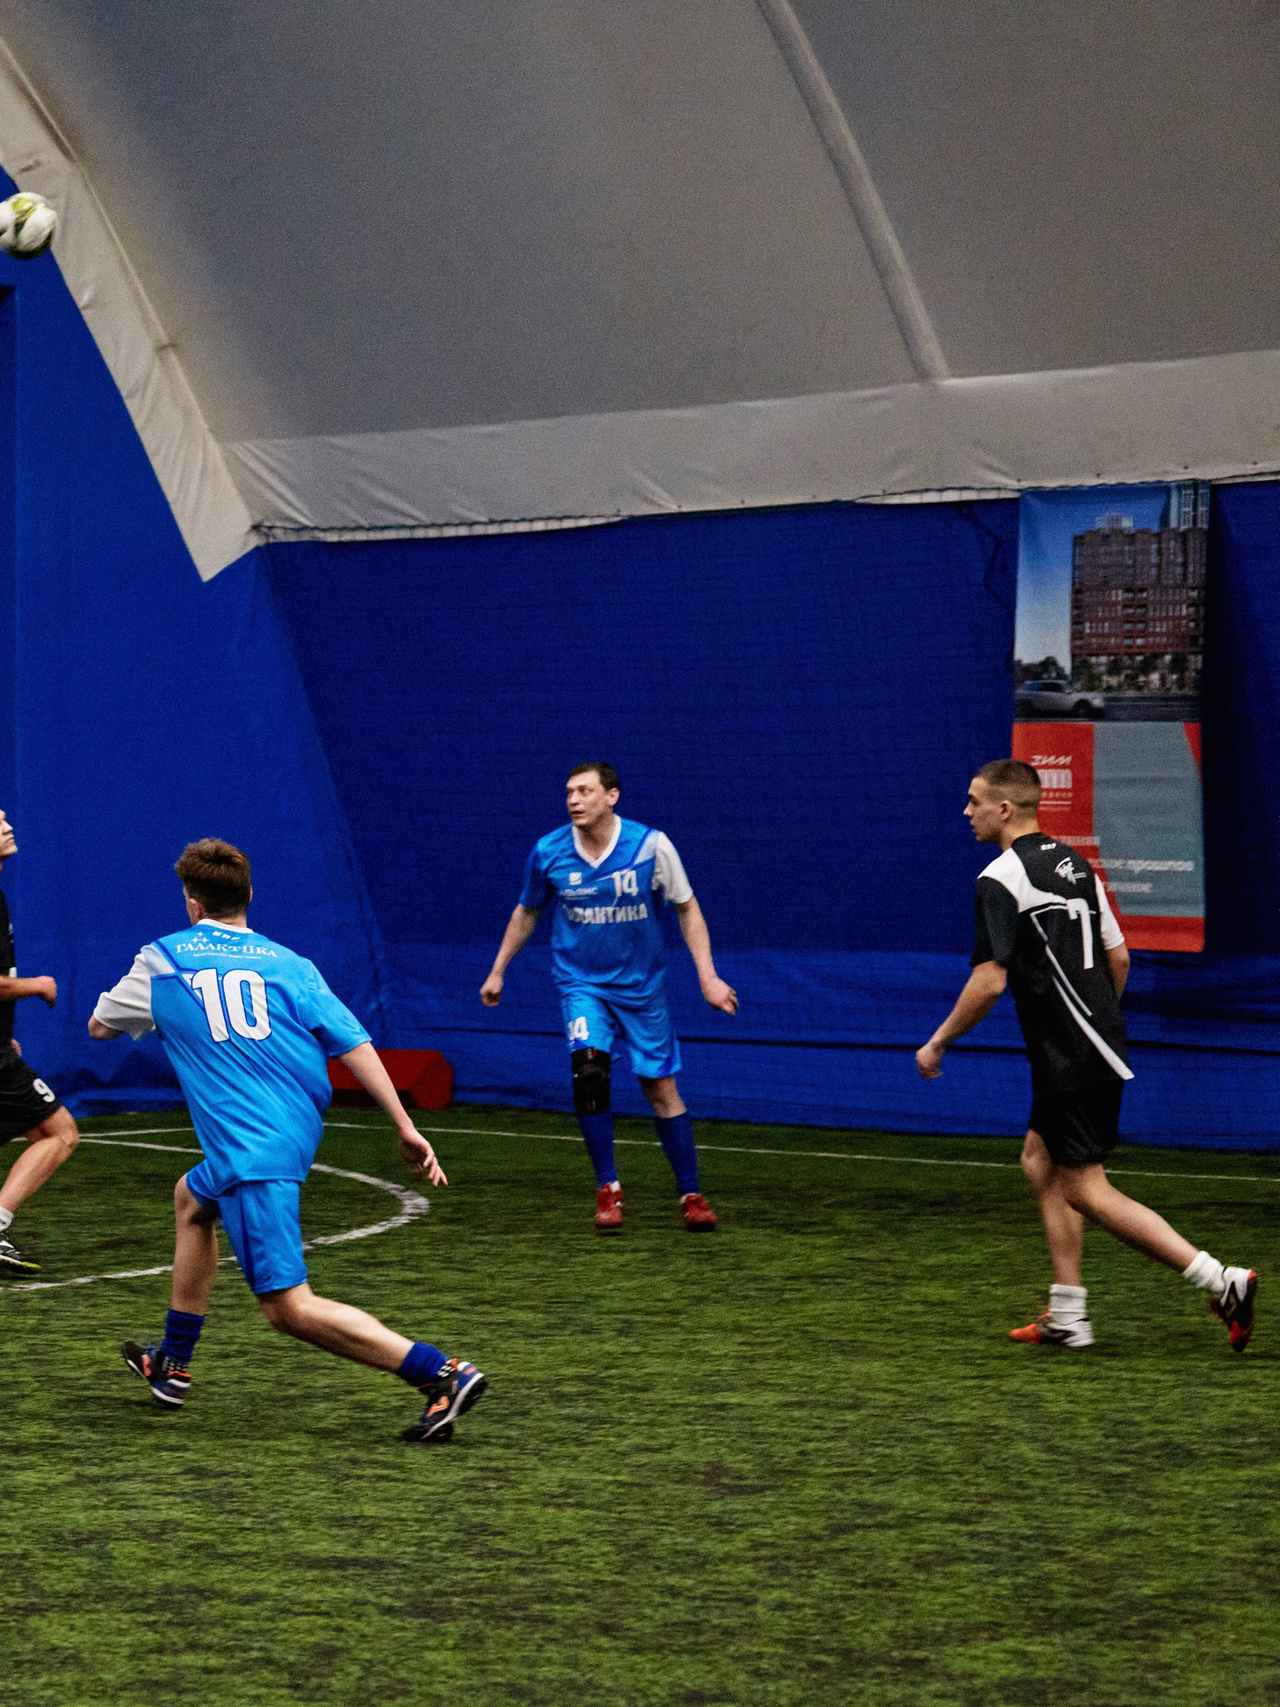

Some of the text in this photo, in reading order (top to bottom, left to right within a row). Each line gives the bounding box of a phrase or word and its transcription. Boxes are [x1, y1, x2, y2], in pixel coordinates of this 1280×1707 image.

[611, 868, 639, 898] 14
[562, 902, 649, 924] АЛАКТИКА
[1065, 897, 1095, 970] 7
[175, 942, 278, 958] ГАЛАКТИКА
[192, 967, 273, 1042] 10
[568, 1016, 590, 1041] 14
[32, 1078, 56, 1103] 9
